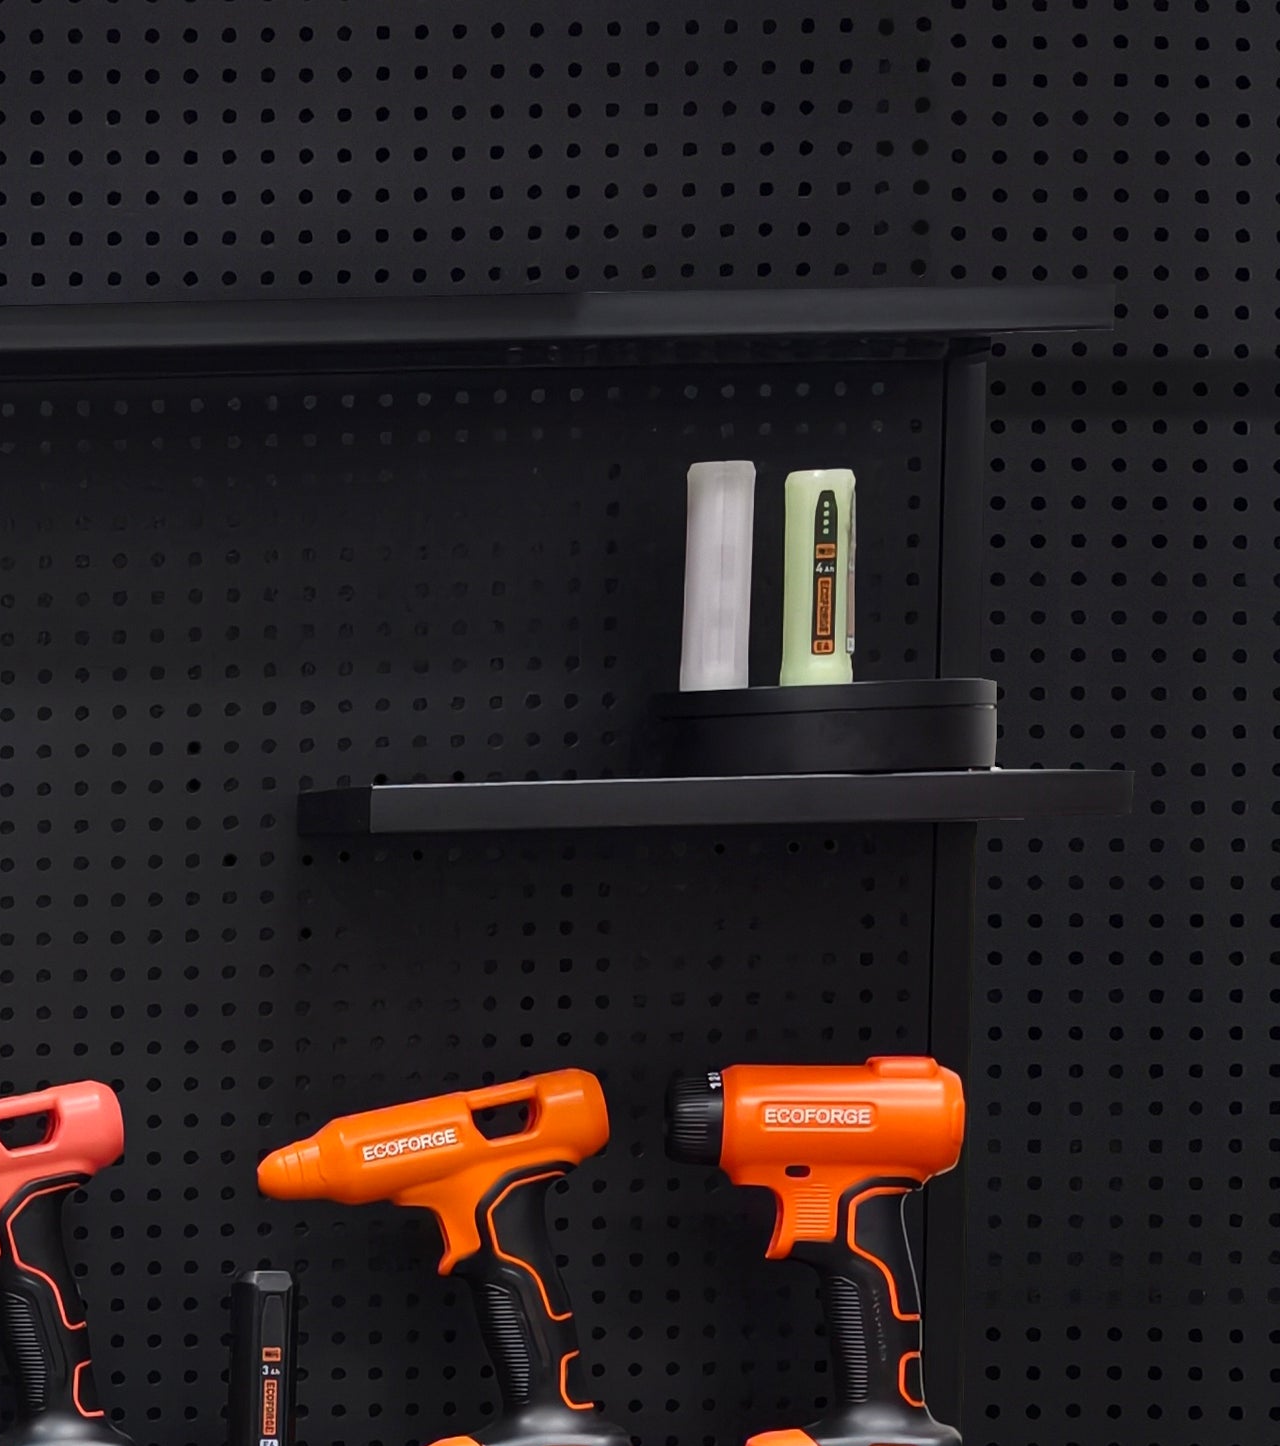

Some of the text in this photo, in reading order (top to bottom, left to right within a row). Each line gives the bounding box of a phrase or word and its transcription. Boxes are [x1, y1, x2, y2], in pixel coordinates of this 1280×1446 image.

[816, 562, 823, 573] 4
[764, 1108, 872, 1124] ECOFORGE
[362, 1128, 457, 1161] ECOFORGE
[262, 1365, 269, 1376] 3
